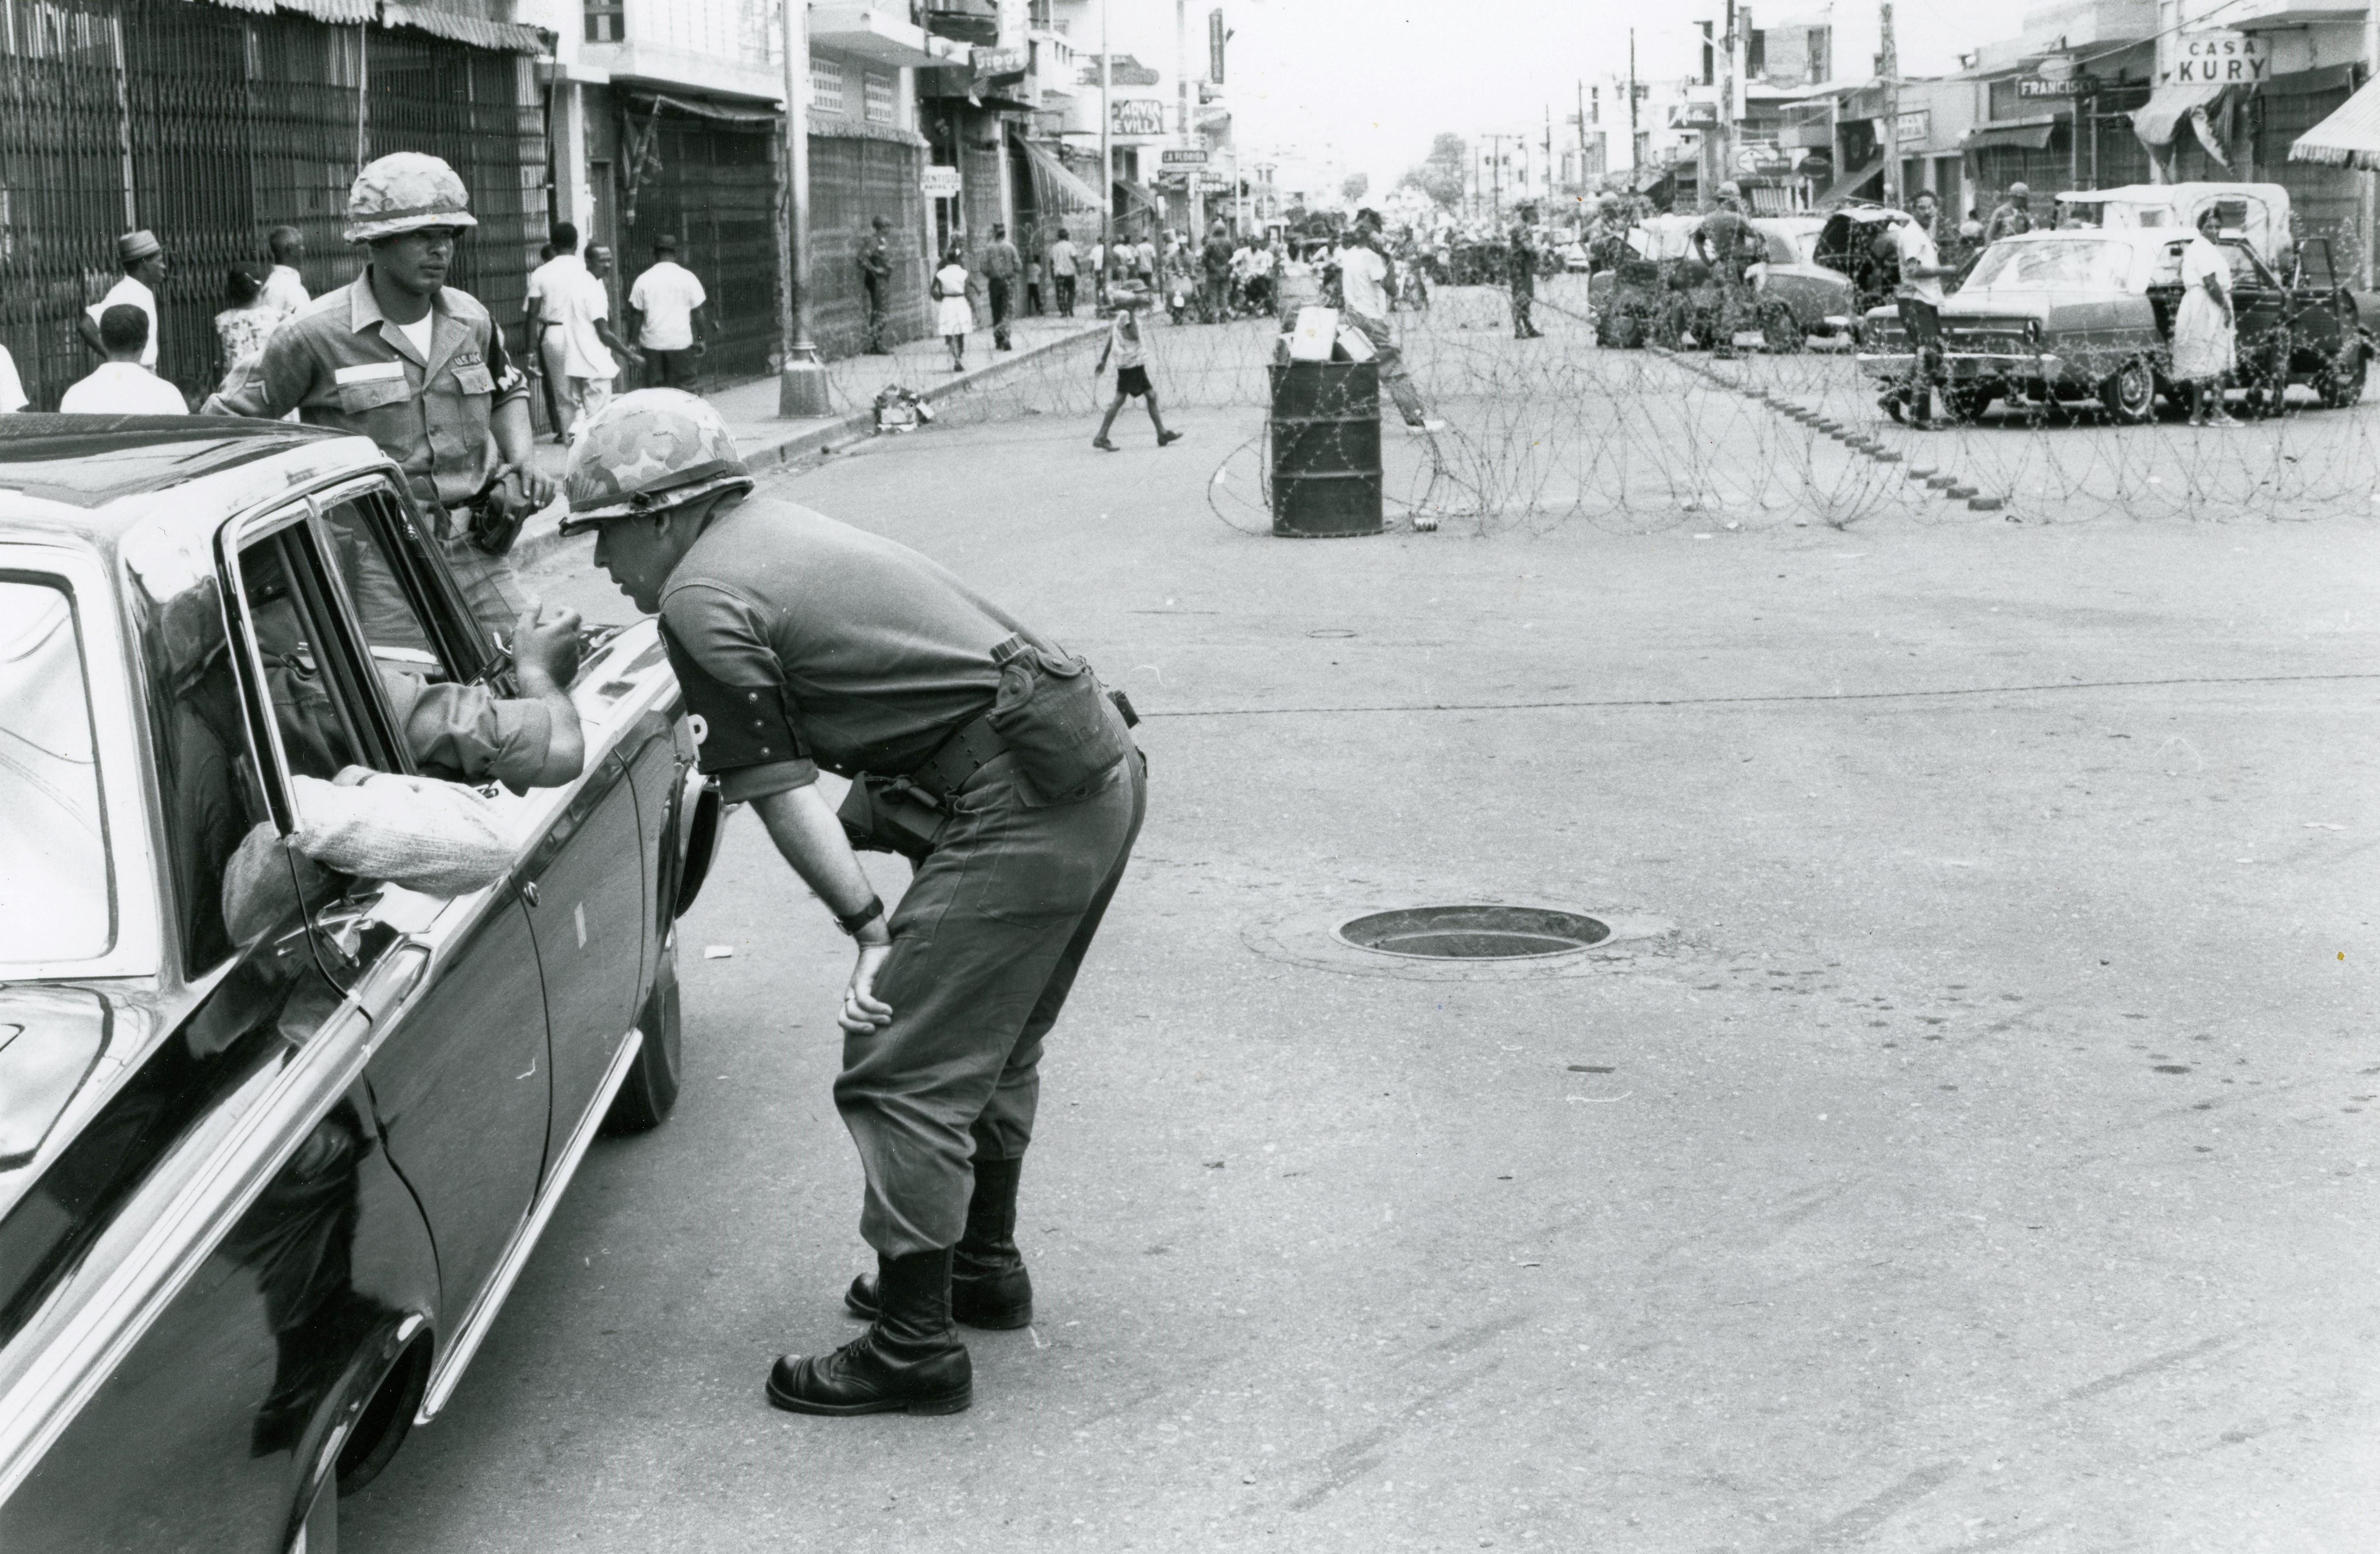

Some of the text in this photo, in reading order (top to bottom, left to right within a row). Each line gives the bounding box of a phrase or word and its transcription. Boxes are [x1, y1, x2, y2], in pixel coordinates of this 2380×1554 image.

[2189, 40, 2256, 56] CASA
[2180, 58, 2265, 81] KURY
[1123, 119, 1160, 133] VILLA
[920, 174, 959, 183] DENTISTA
